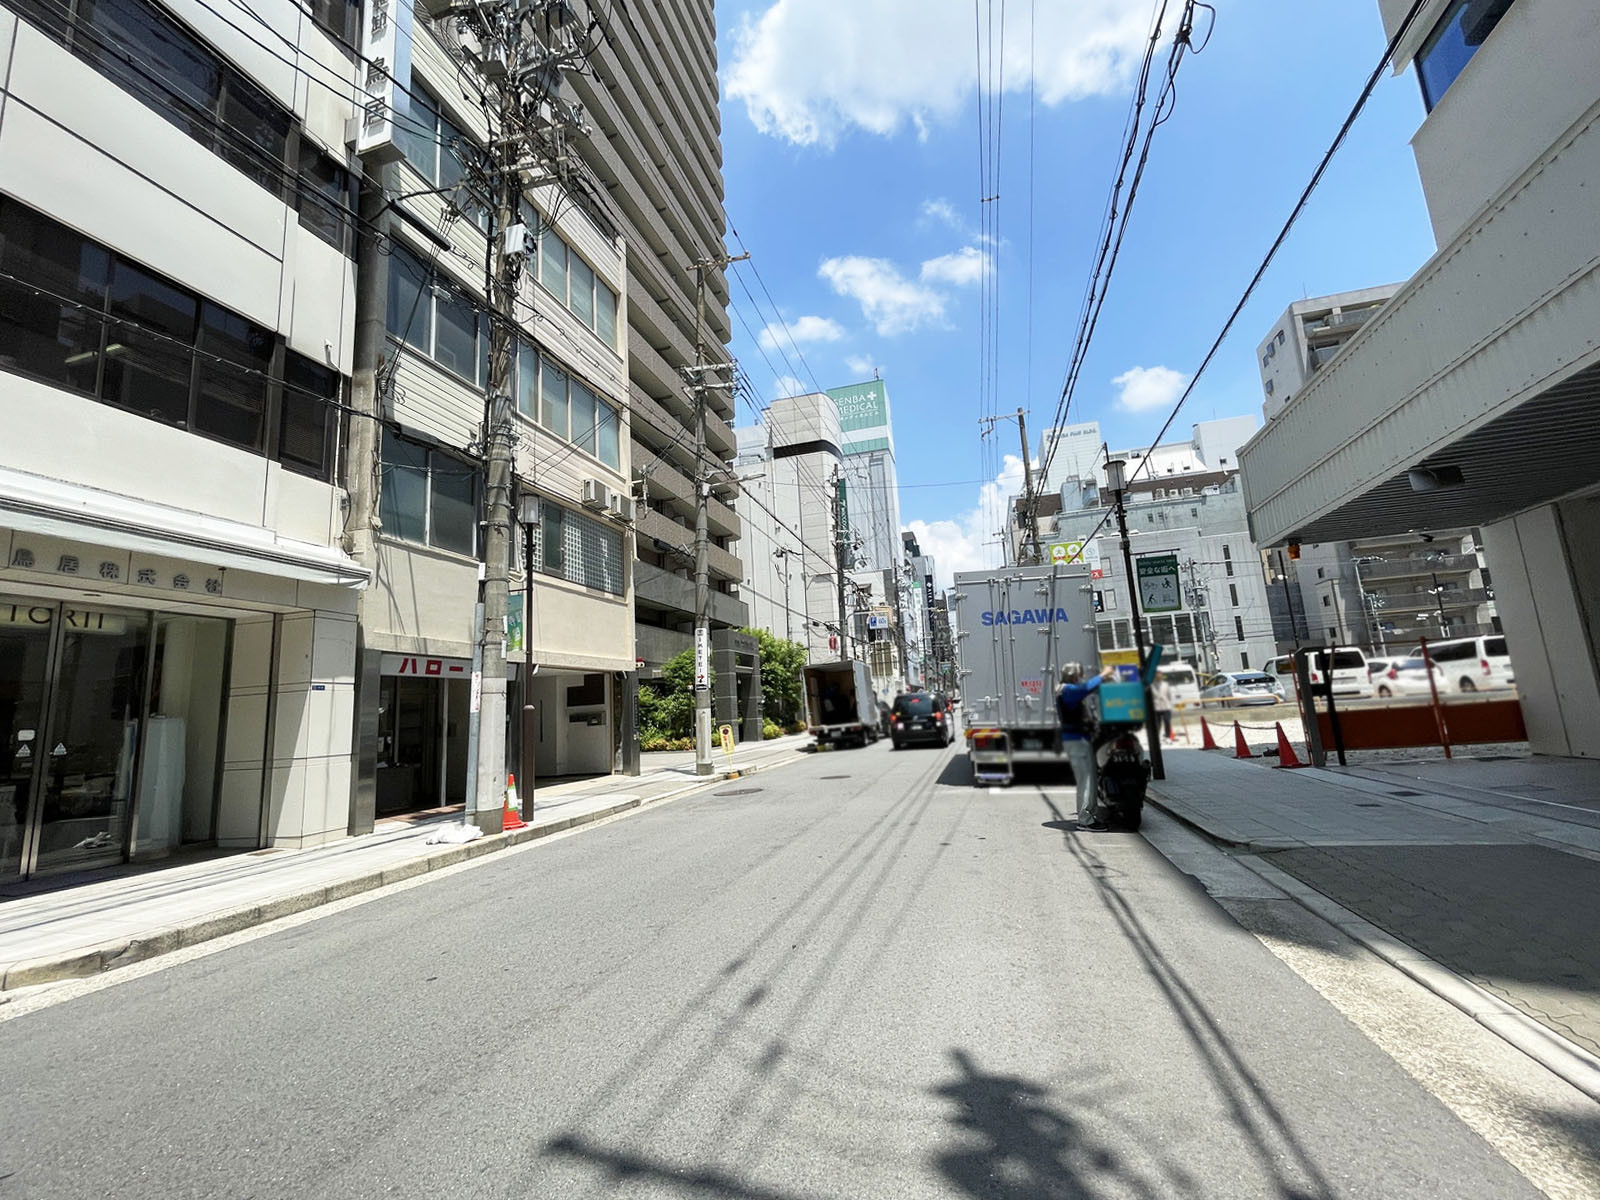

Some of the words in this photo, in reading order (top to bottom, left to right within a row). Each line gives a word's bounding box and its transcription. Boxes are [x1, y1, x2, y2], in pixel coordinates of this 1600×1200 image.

[11, 548, 222, 594] 鳥居株式会社
[981, 607, 1069, 626] SAGAWA
[398, 657, 472, 676] ハロー
